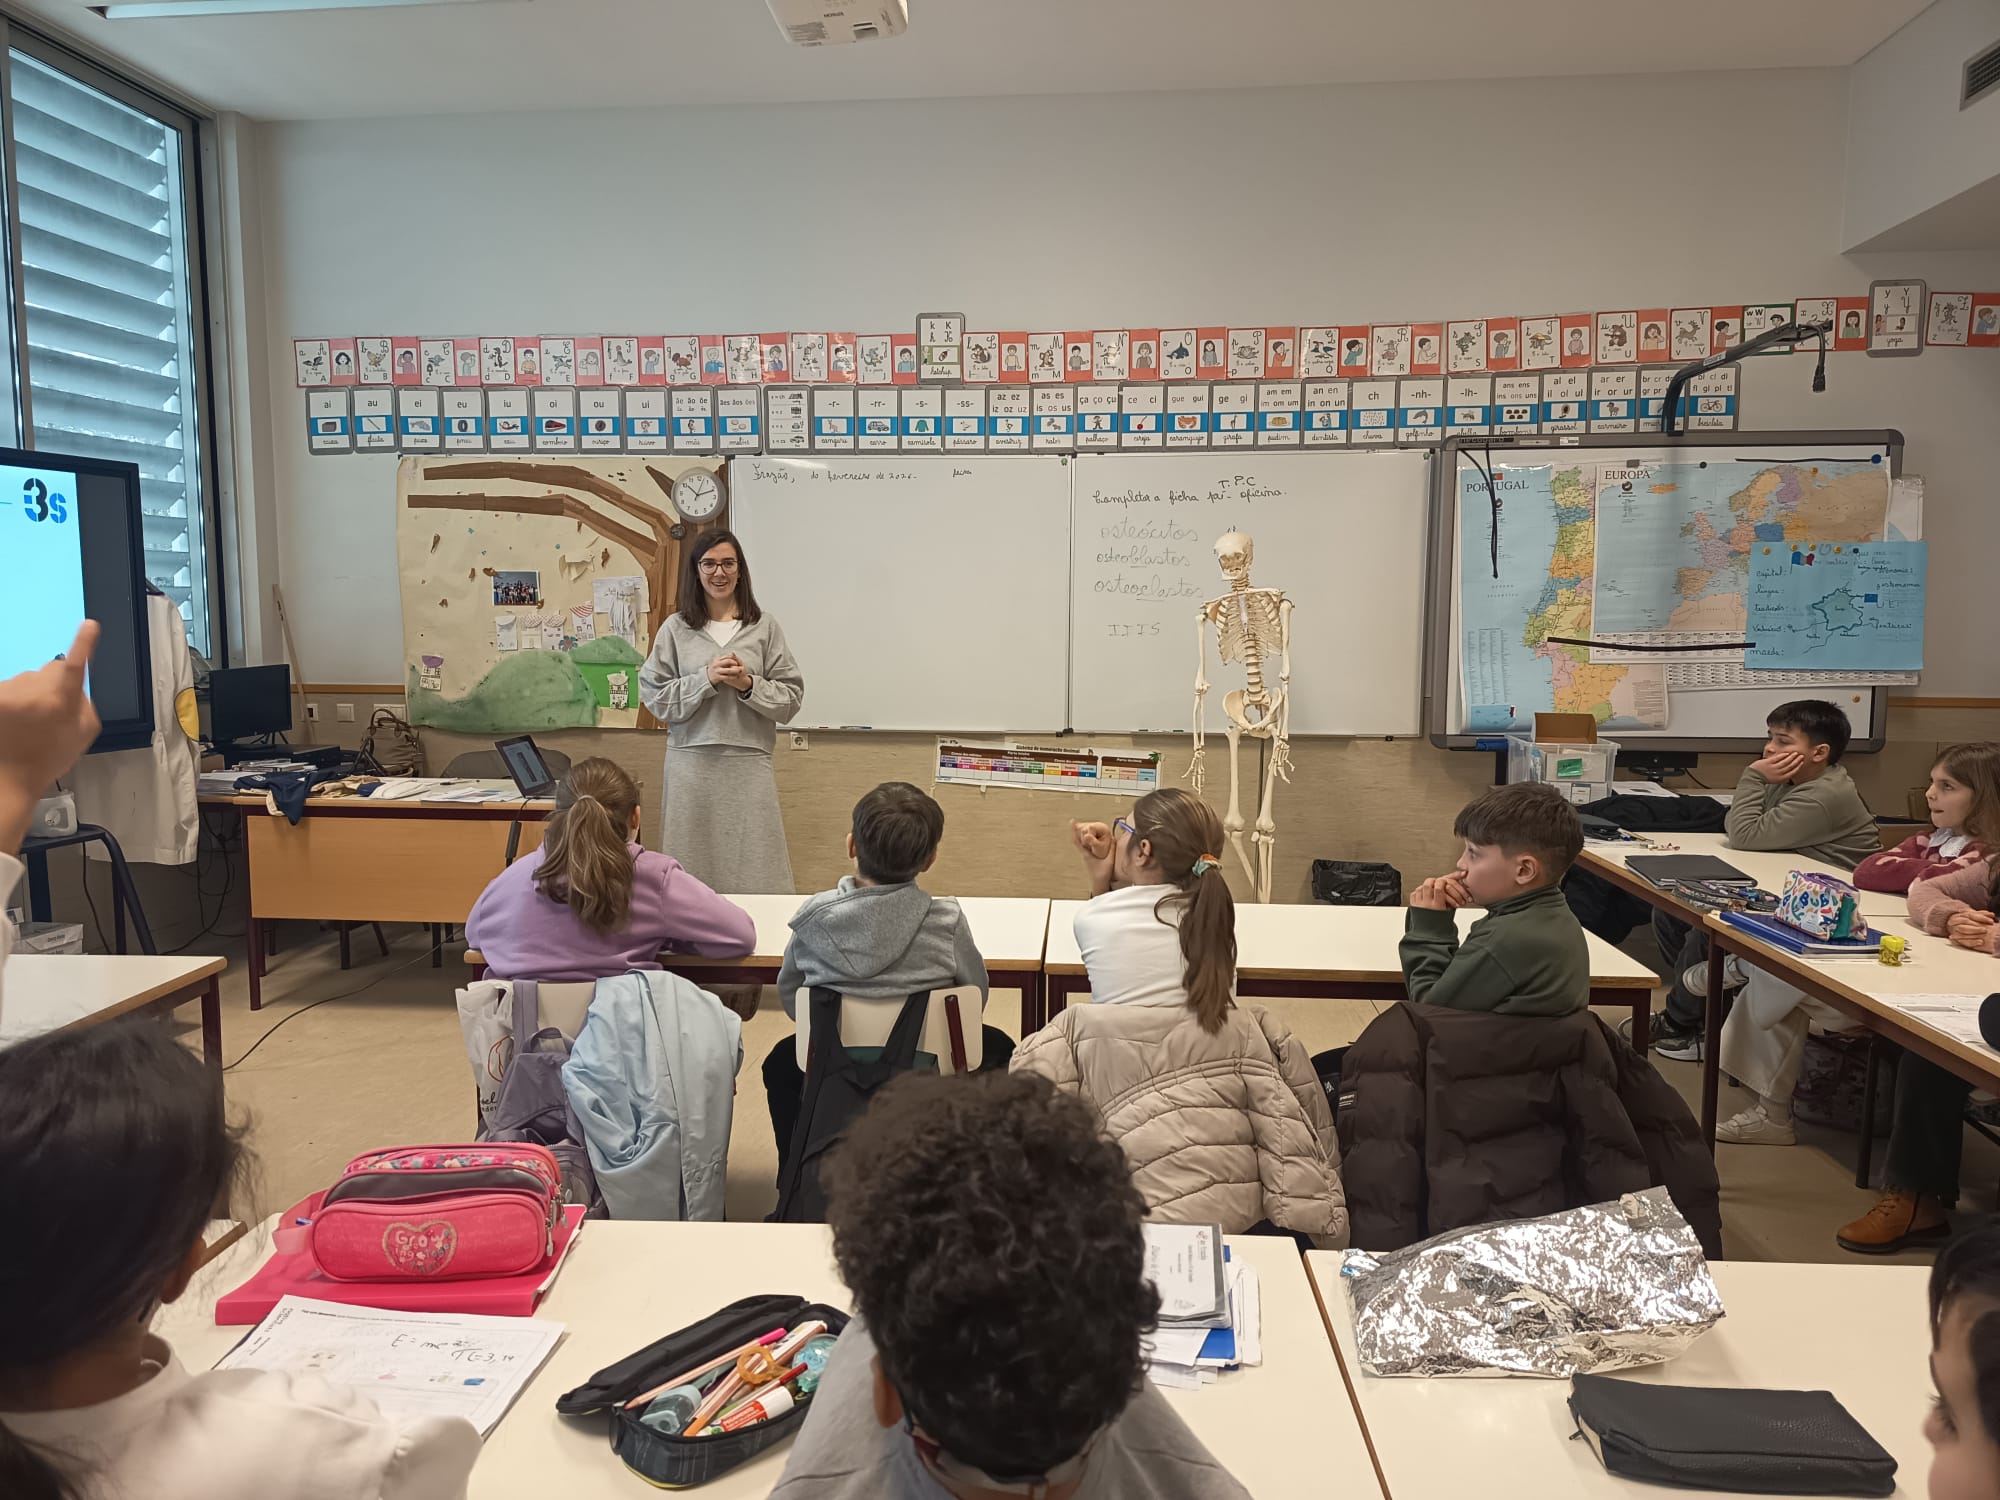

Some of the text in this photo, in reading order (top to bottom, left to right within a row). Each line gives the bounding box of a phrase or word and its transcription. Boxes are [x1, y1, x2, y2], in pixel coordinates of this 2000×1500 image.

[930, 367, 952, 376] ketchup
[1326, 365, 1332, 373] Q
[1554, 376, 1561, 384] al
[1368, 392, 1380, 400] ch
[1460, 388, 1477, 398] -lh-
[1080, 396, 1116, 405] ça ço çu
[1193, 395, 1203, 403] gui
[1219, 394, 1247, 404] ge gi
[1551, 421, 1576, 434] girassol
[1086, 434, 1108, 443] palhaço
[1224, 434, 1242, 444] girafa
[1268, 432, 1290, 442] pudim
[1312, 432, 1338, 440] dentista
[1363, 431, 1382, 440] chuva
[1406, 428, 1434, 441] golfinho
[1604, 470, 1650, 480] EUROPA
[1466, 480, 1529, 492] PORUGAL
[1170, 490, 1199, 505] ficha
[1100, 516, 1198, 542] osteócitos
[1096, 546, 1190, 566] osteoblastos
